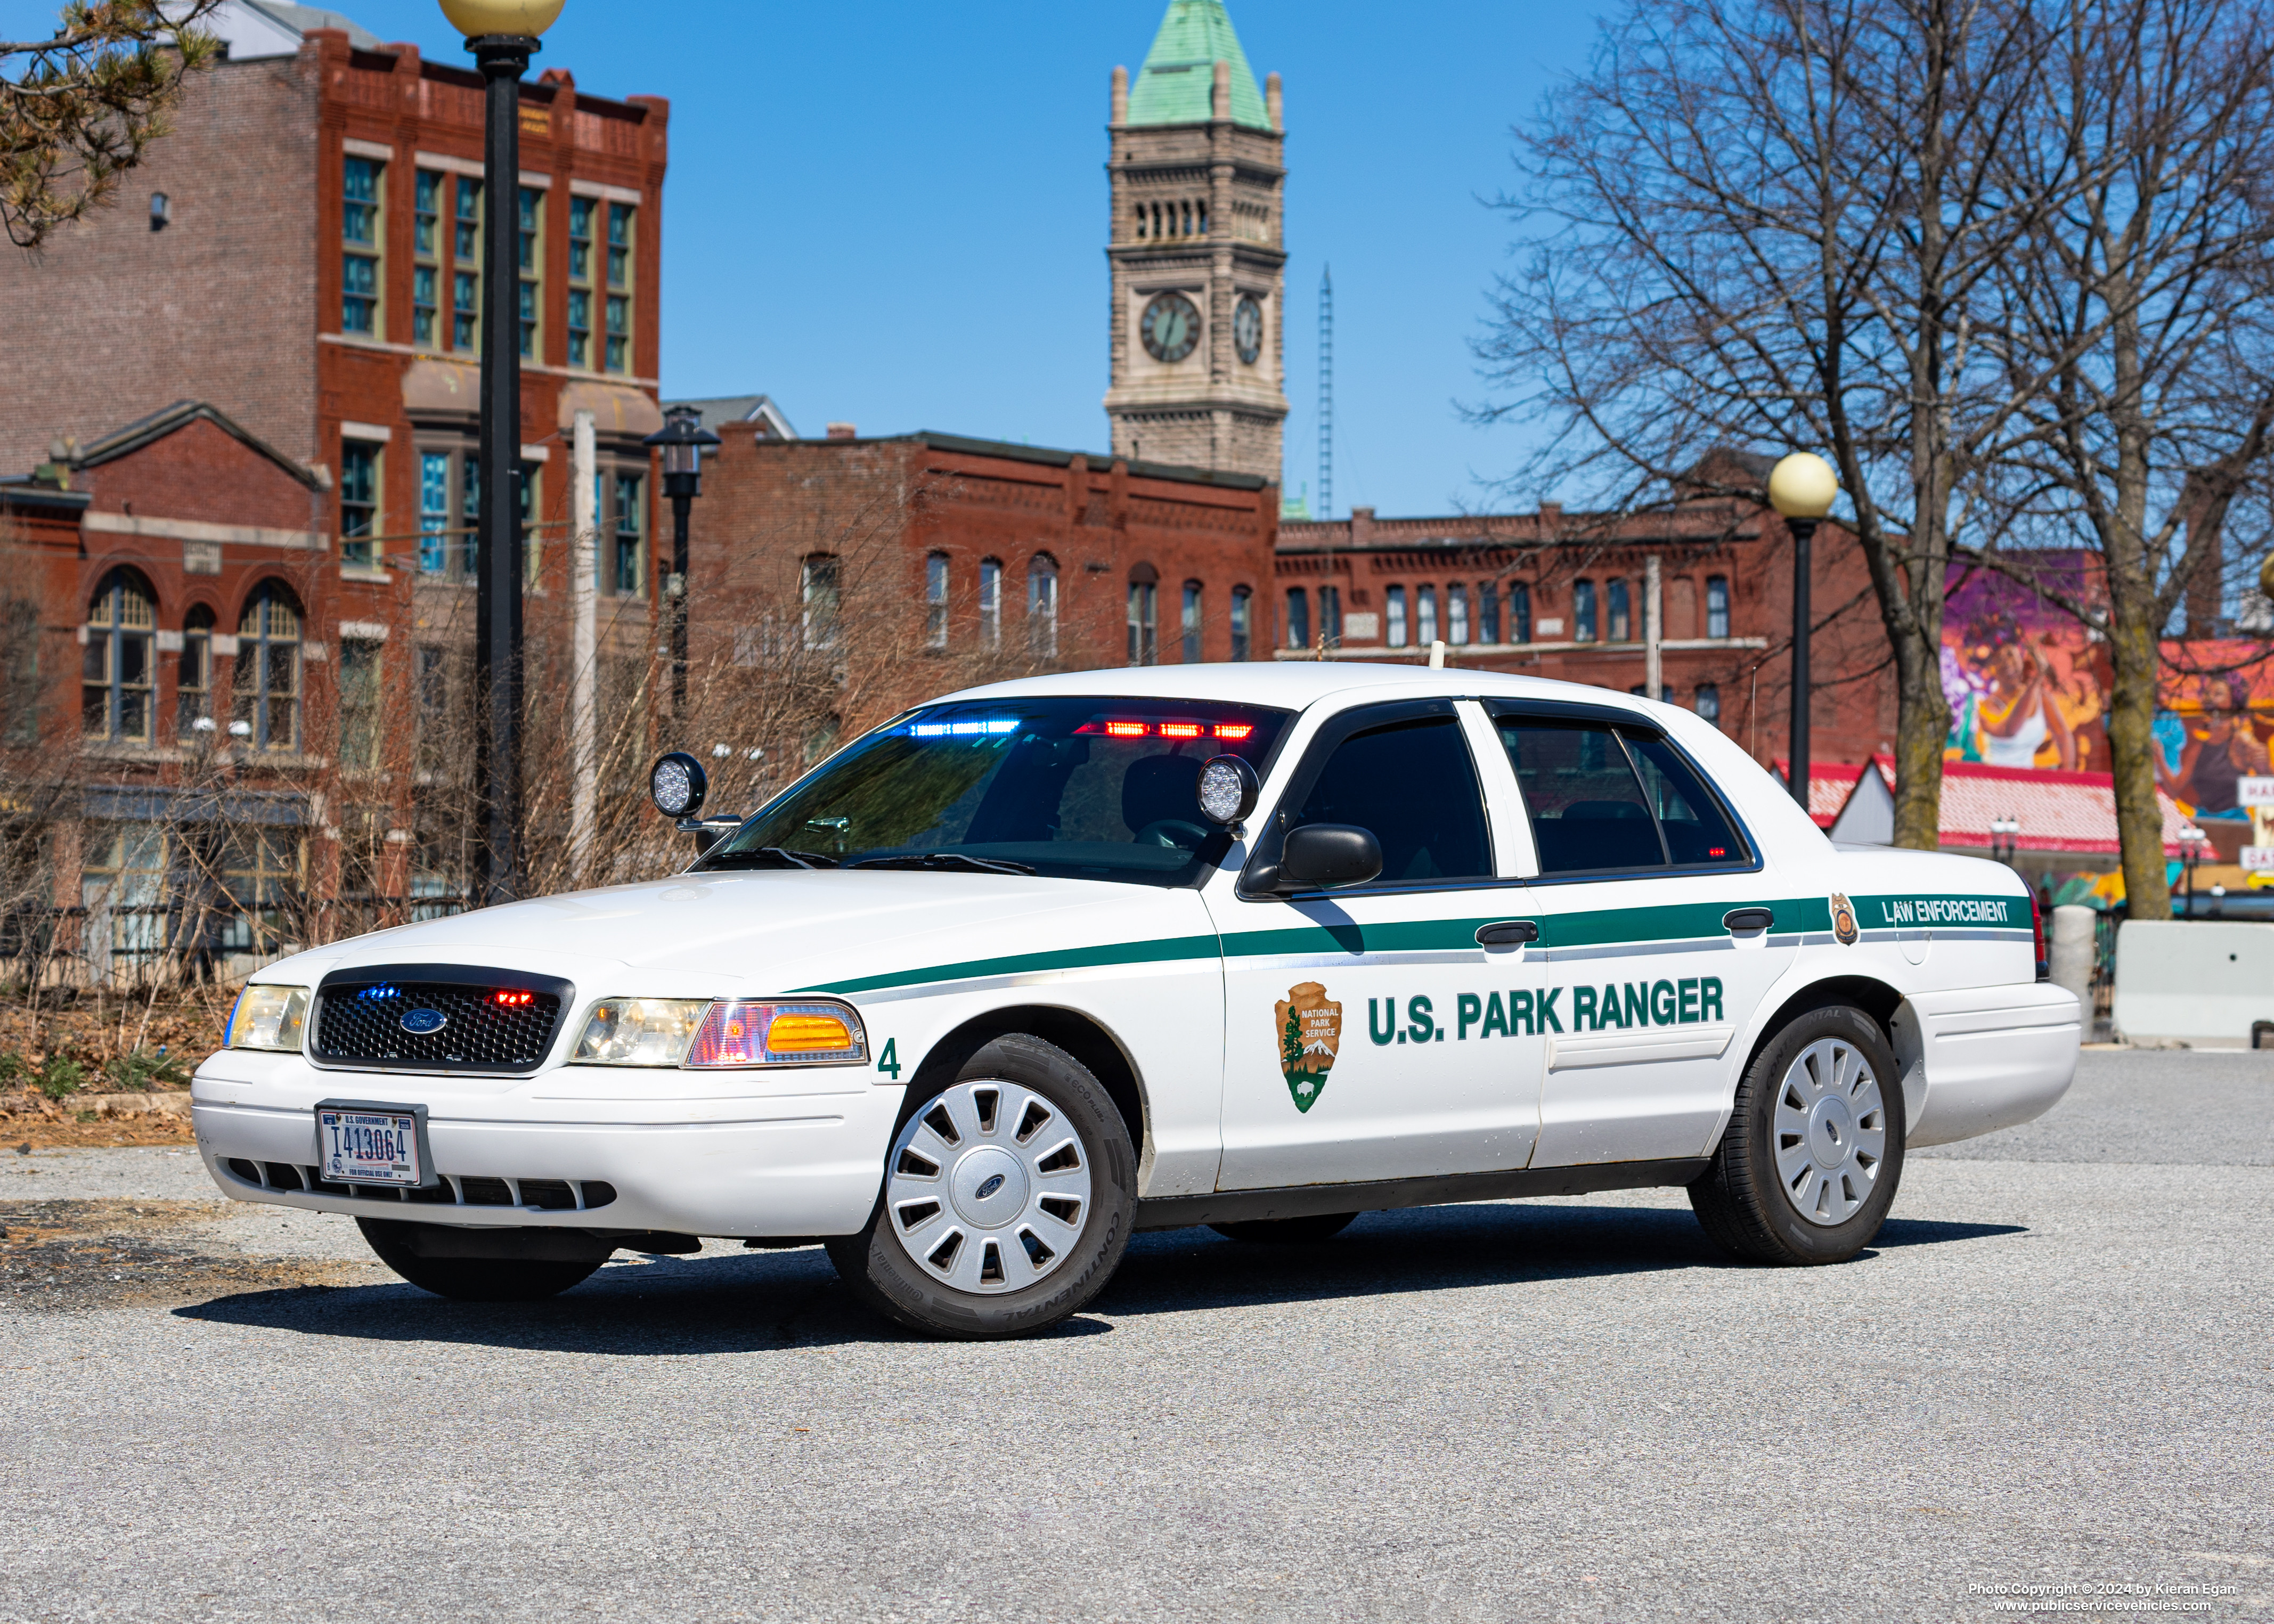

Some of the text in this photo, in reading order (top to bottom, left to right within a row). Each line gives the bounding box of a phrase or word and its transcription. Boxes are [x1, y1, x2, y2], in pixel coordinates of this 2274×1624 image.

[1881, 900, 2008, 922] LAW ENFORCEMENT
[1301, 1008, 1339, 1018] NATIONAL
[1368, 976, 1724, 1046] U.S. PARK RANGER
[1311, 1018, 1330, 1027] PARK
[1306, 1028, 1335, 1038] SERVICE
[878, 1038, 901, 1080] 4
[345, 1115, 388, 1125] U.S. GOVERNMENT
[1002, 1212, 1120, 1321] CONTINENTAL
